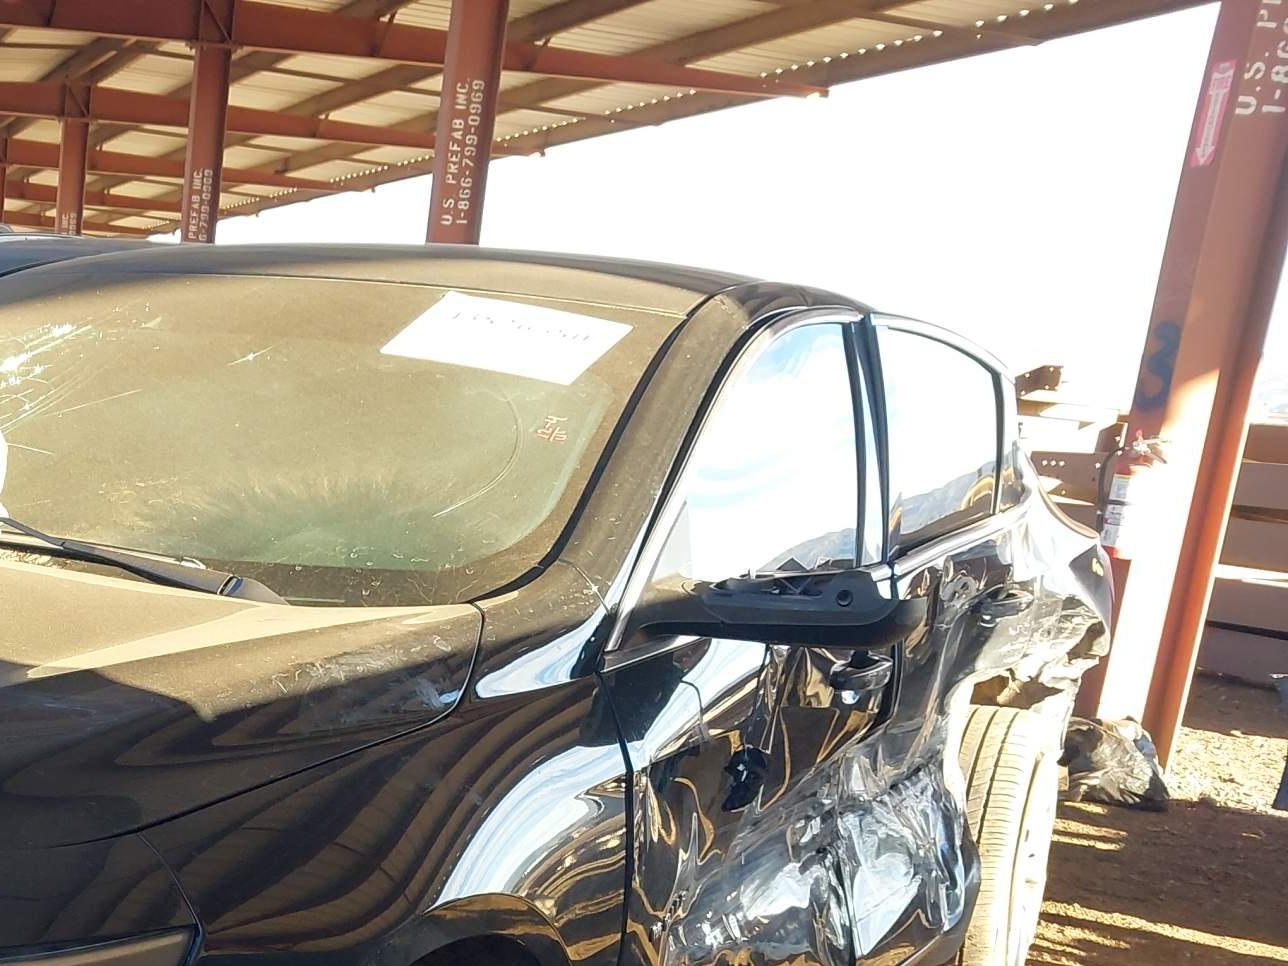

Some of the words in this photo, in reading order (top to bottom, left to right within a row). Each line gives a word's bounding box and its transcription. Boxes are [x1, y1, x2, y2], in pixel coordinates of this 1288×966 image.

[454, 77, 470, 110] INC.
[1234, 51, 1270, 115] U.S.
[445, 118, 465, 184] PREFAB
[456, 79, 485, 225] 1-866-799-0969
[188, 195, 201, 239] PREFAB
